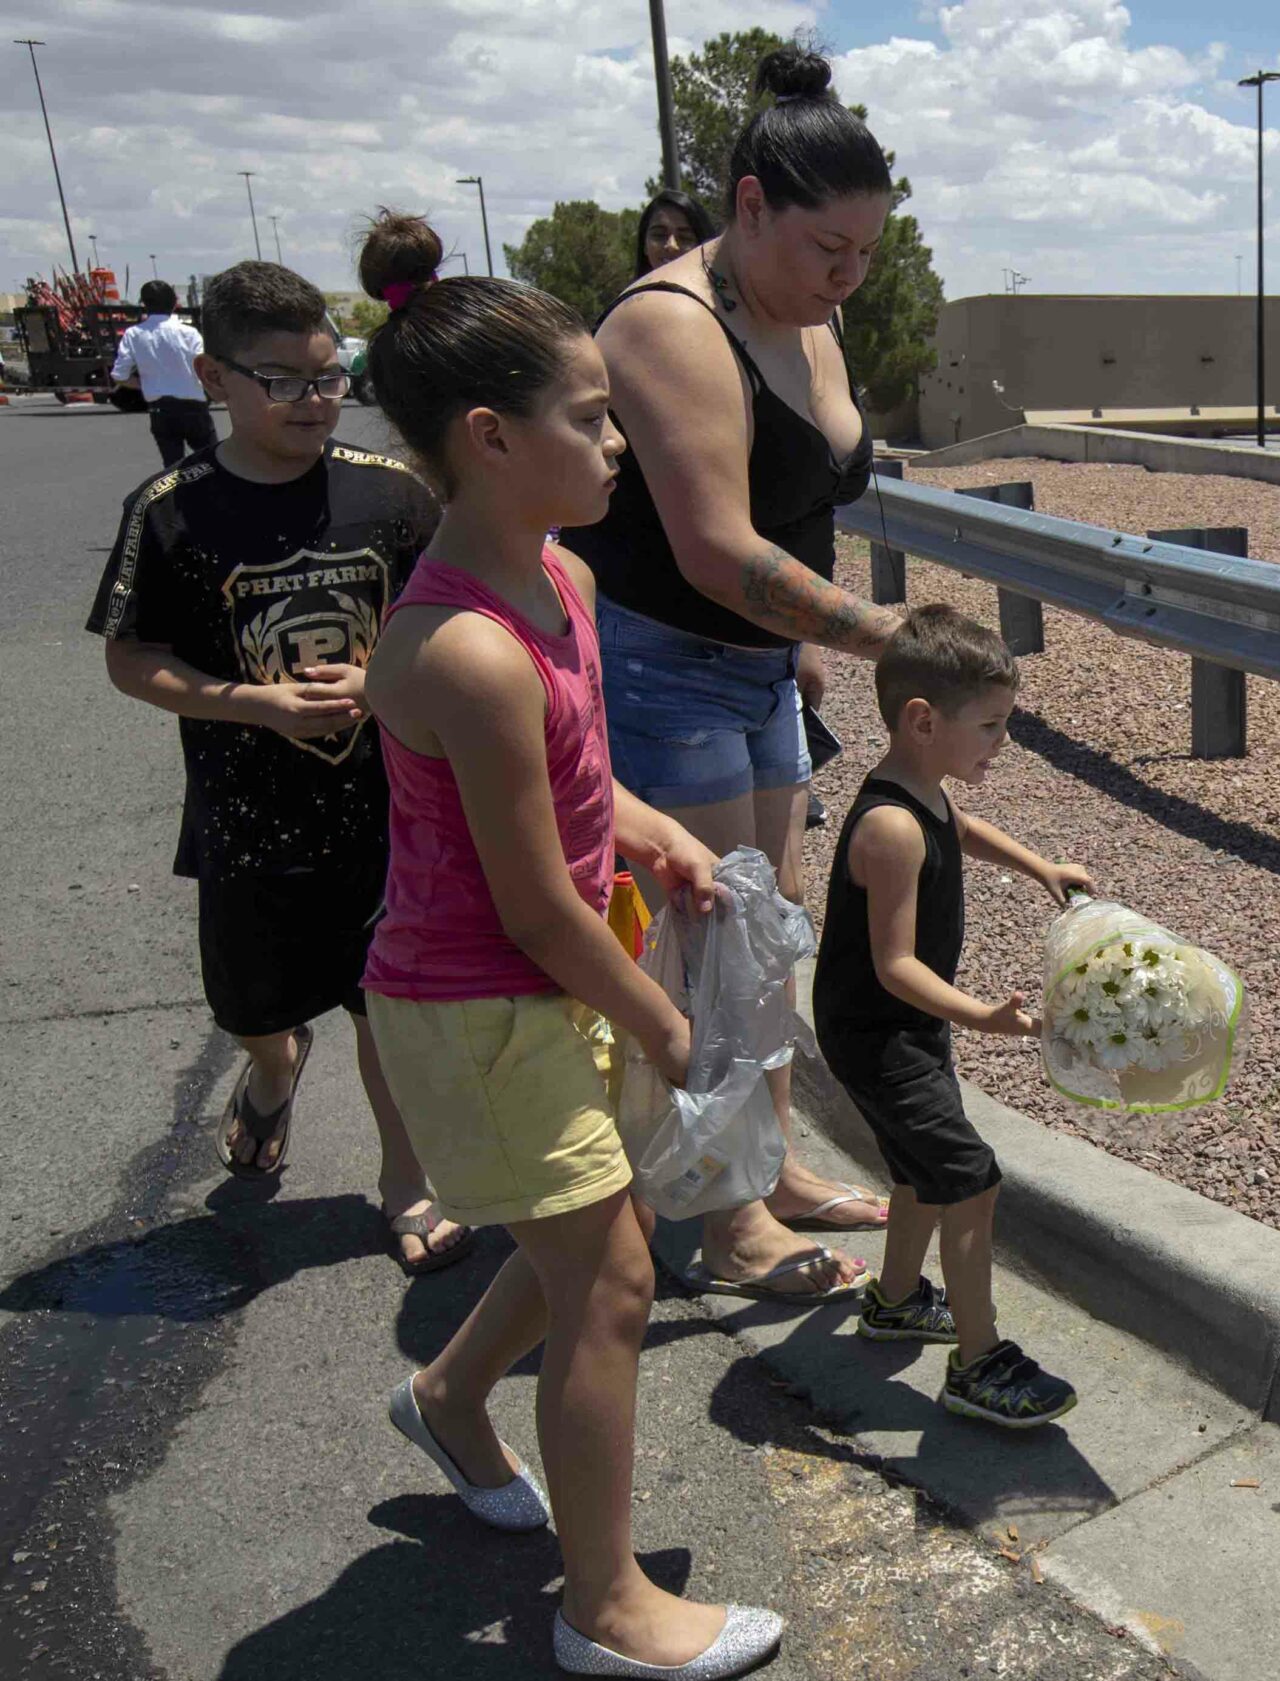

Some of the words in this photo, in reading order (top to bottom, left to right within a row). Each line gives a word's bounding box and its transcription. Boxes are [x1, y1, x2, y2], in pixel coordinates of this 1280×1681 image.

[236, 574, 304, 598] PHAT
[306, 565, 379, 588] FARM
[288, 626, 346, 674] P
